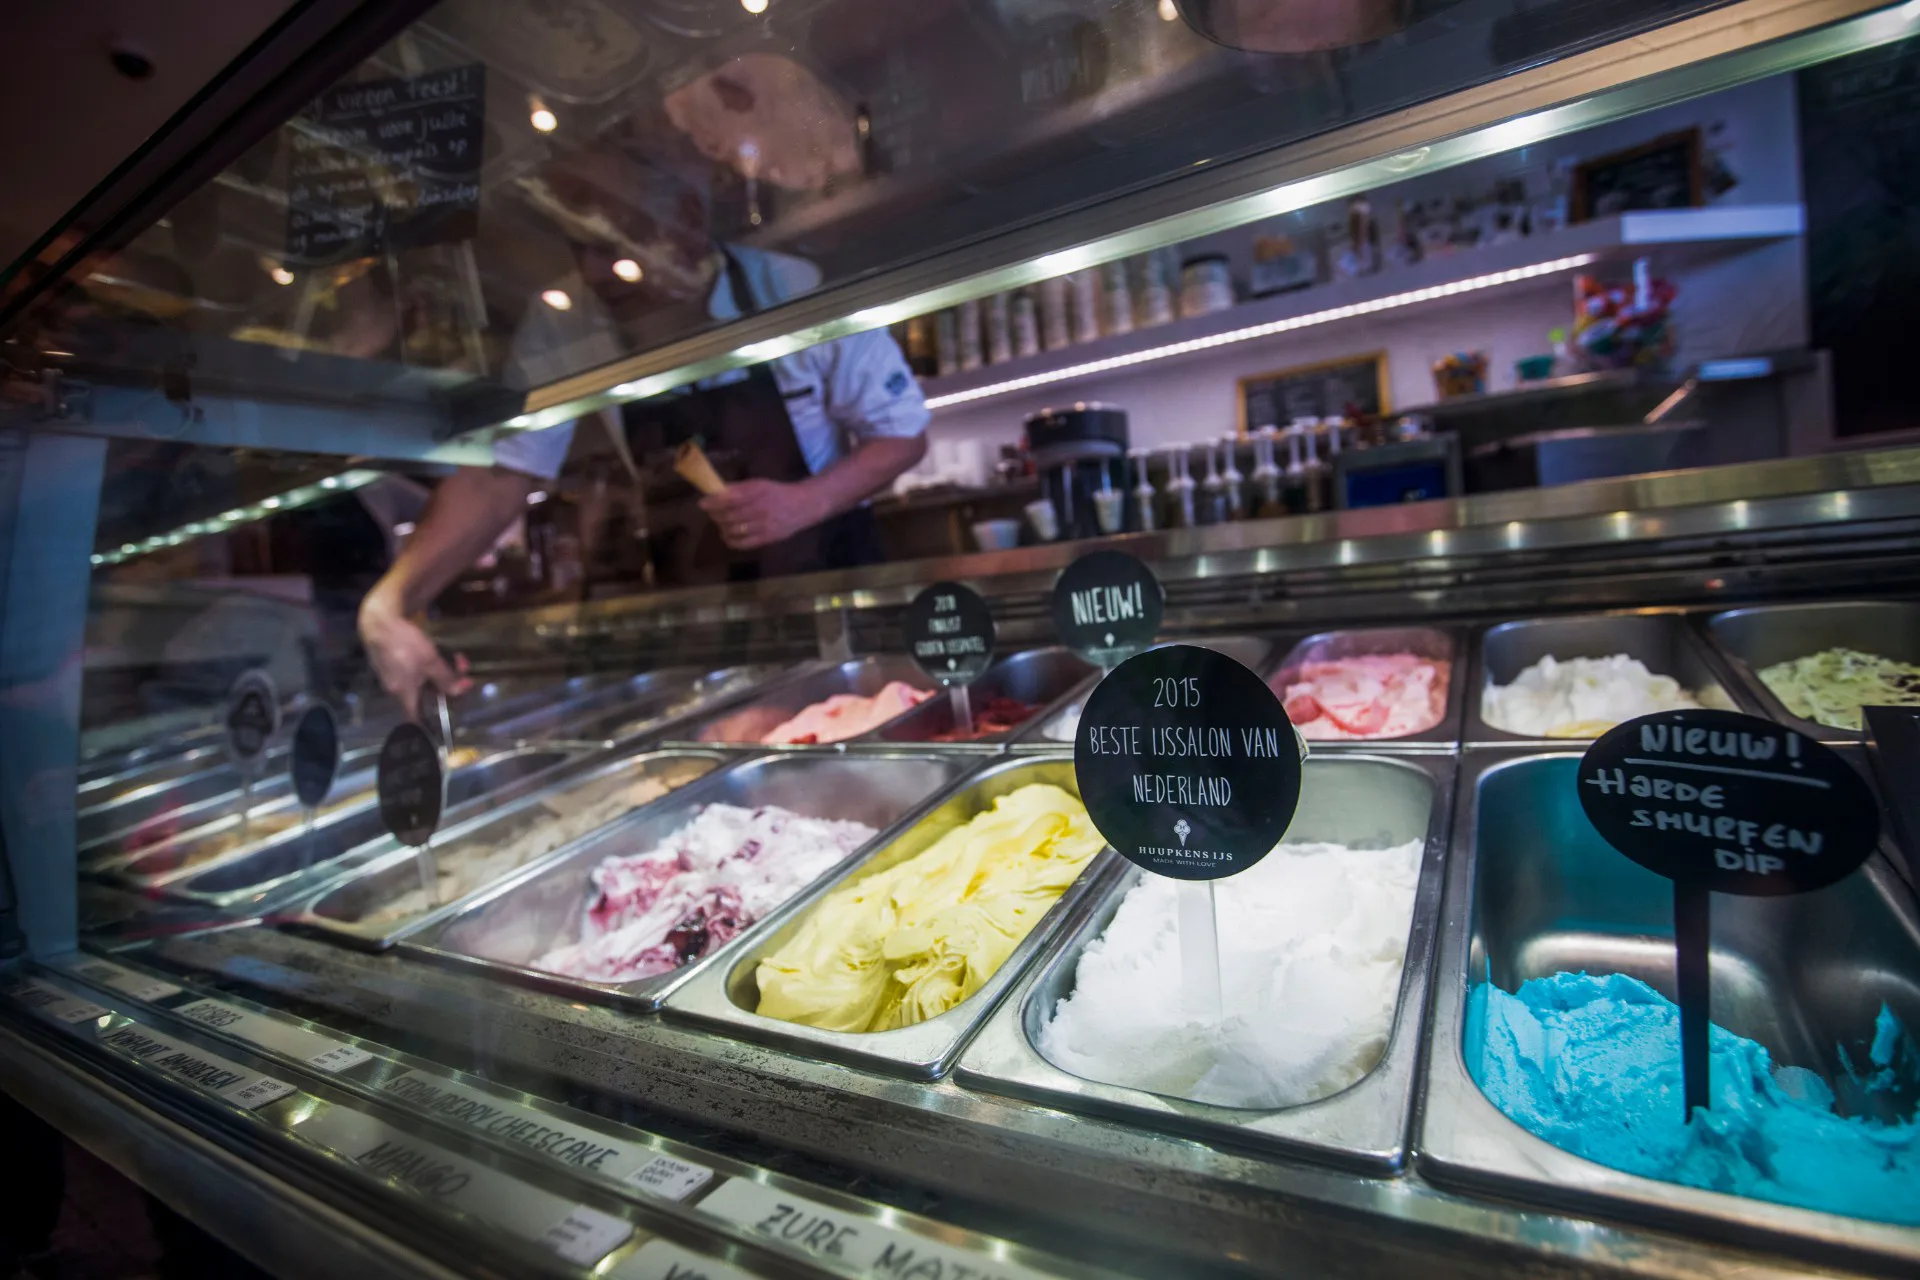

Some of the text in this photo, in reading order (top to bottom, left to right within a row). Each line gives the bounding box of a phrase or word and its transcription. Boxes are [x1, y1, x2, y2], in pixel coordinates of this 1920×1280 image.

[1070, 582, 1144, 626] NIEUW!
[1152, 677, 1201, 708] 2015
[1089, 726, 1279, 758] BESTE IJSSALON VAN
[1133, 774, 1232, 807] NEDERLAND
[1138, 846, 1233, 861] HUUPKENS IJS
[103, 1028, 172, 1059] YOGHURT
[383, 1076, 619, 1171] STRAWBERRY CHEESCAKE
[354, 1141, 472, 1197] MANGO
[755, 1203, 860, 1257] ZURE
